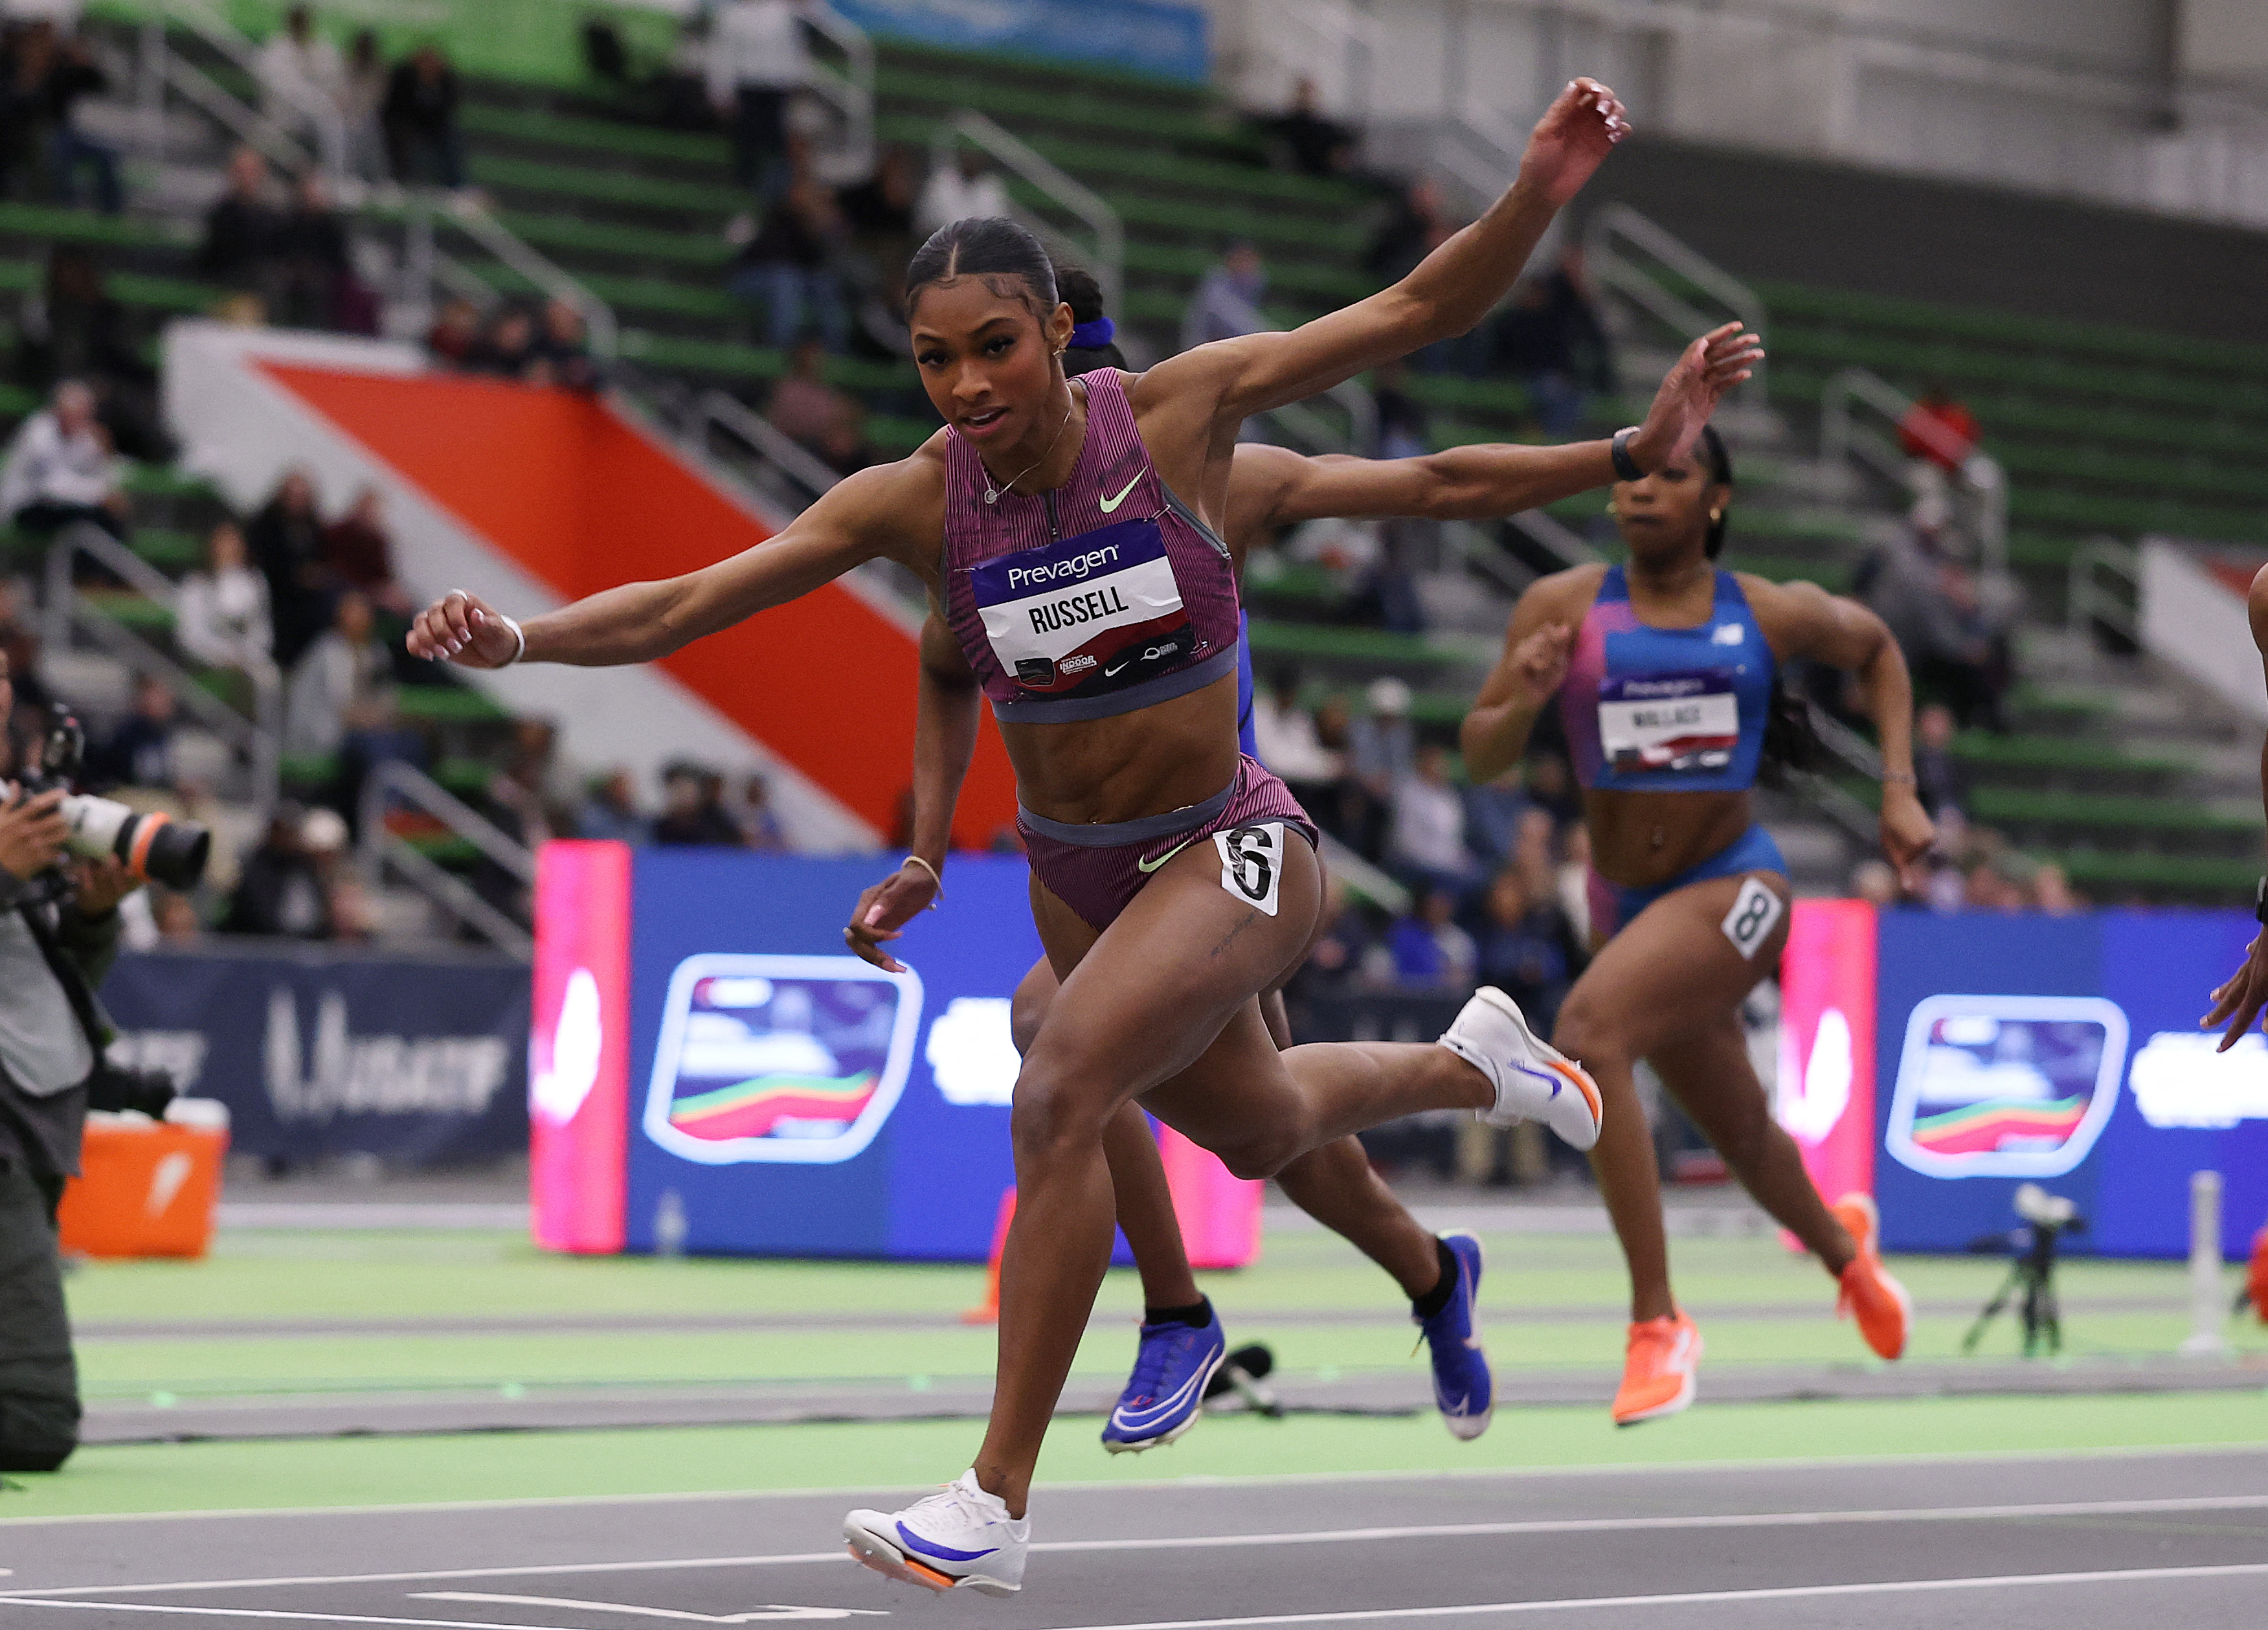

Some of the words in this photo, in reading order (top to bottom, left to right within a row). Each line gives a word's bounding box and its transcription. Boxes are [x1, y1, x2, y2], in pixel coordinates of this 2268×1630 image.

[1008, 545, 1119, 589] Prevagen
[1028, 586, 1129, 634] RUSSELL
[1059, 655, 1097, 673] INDOOR
[1226, 827, 1273, 901] 6
[1735, 892, 1769, 942] 8
